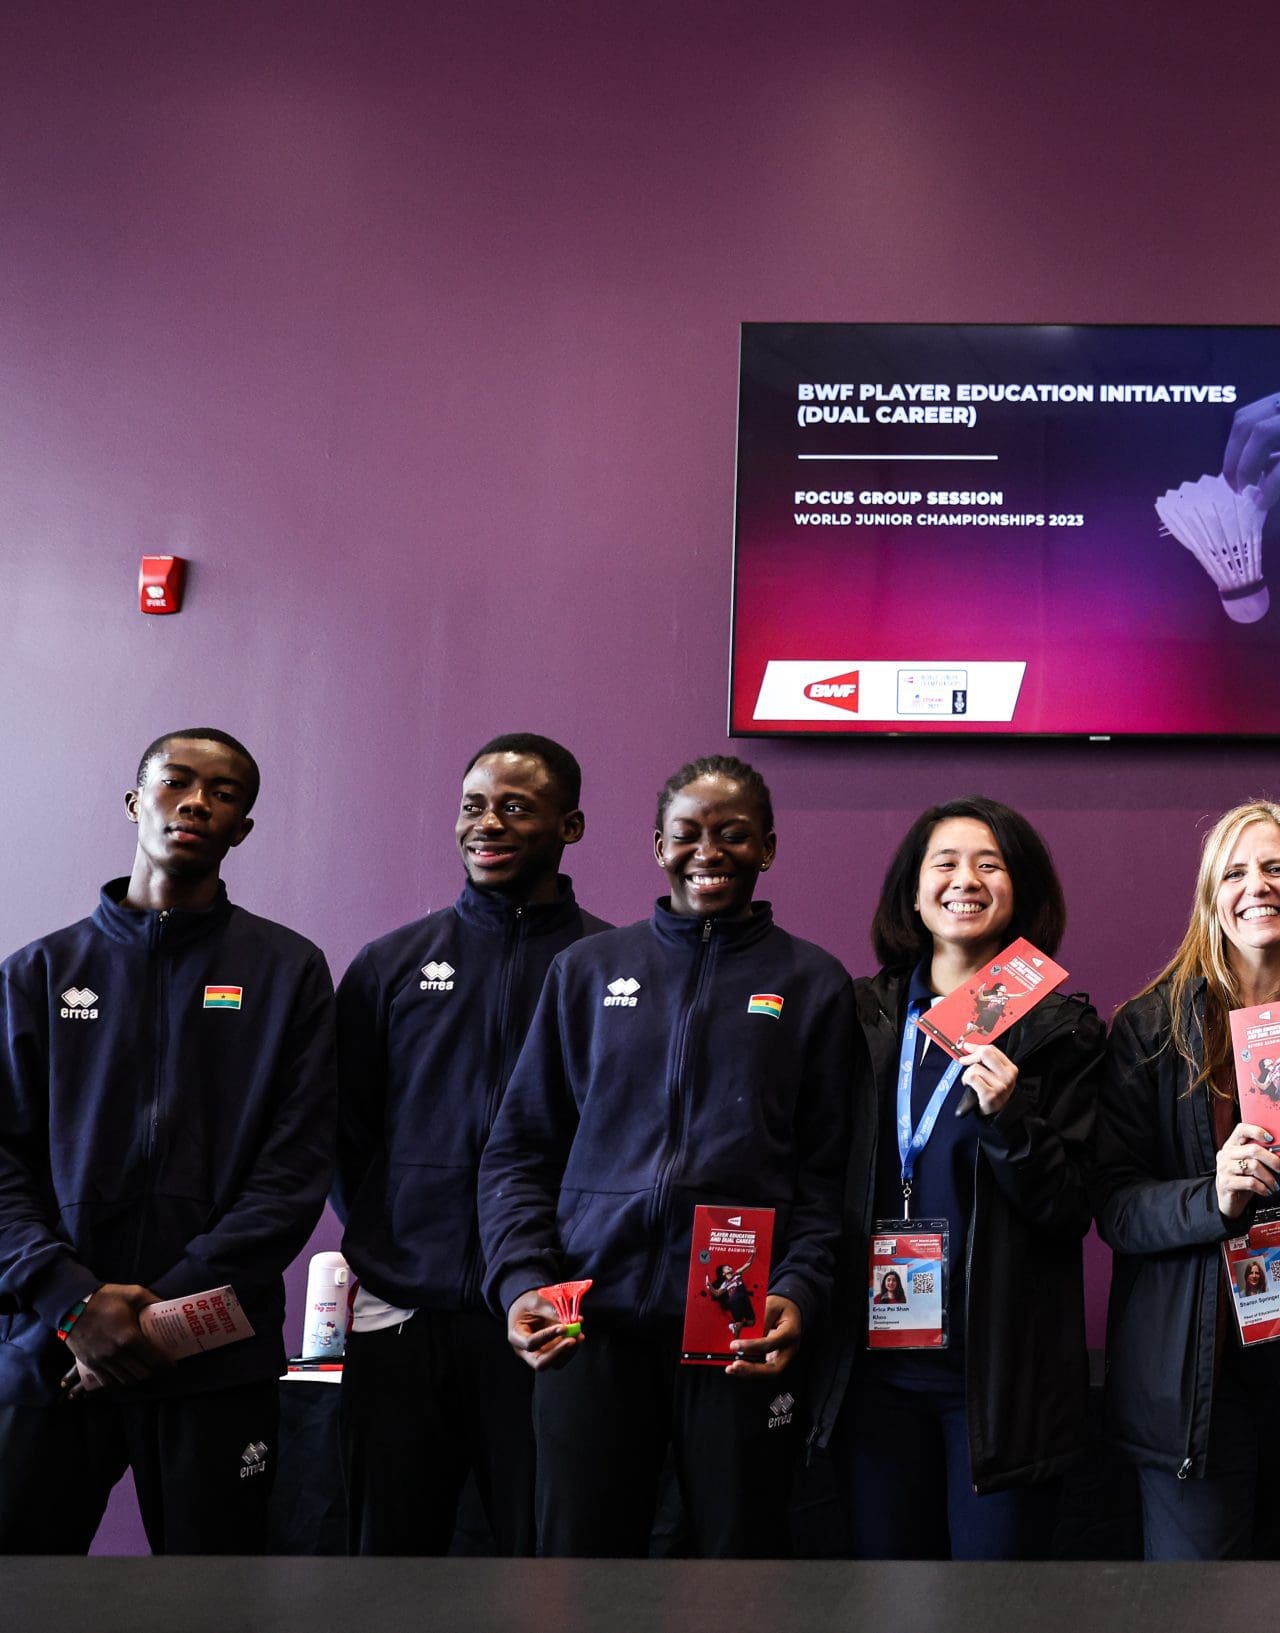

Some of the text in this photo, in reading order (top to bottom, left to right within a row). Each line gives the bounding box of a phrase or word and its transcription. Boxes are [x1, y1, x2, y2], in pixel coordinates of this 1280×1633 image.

[798, 384, 1237, 403] BWF PLAYER EDUCATION INITIATIVES
[797, 405, 977, 428] (DUAL CAREER)
[794, 491, 1003, 506] FOCUS GROUP SESSION
[794, 513, 1084, 527] WORLD JUNIOR CHAMPIONSHIPS 2023
[809, 684, 857, 699] BWF
[60, 1008, 99, 1020] errea
[182, 1303, 206, 1338] CAREER
[196, 1299, 220, 1336] OF DUAL
[209, 1295, 237, 1334] BENEFITS
